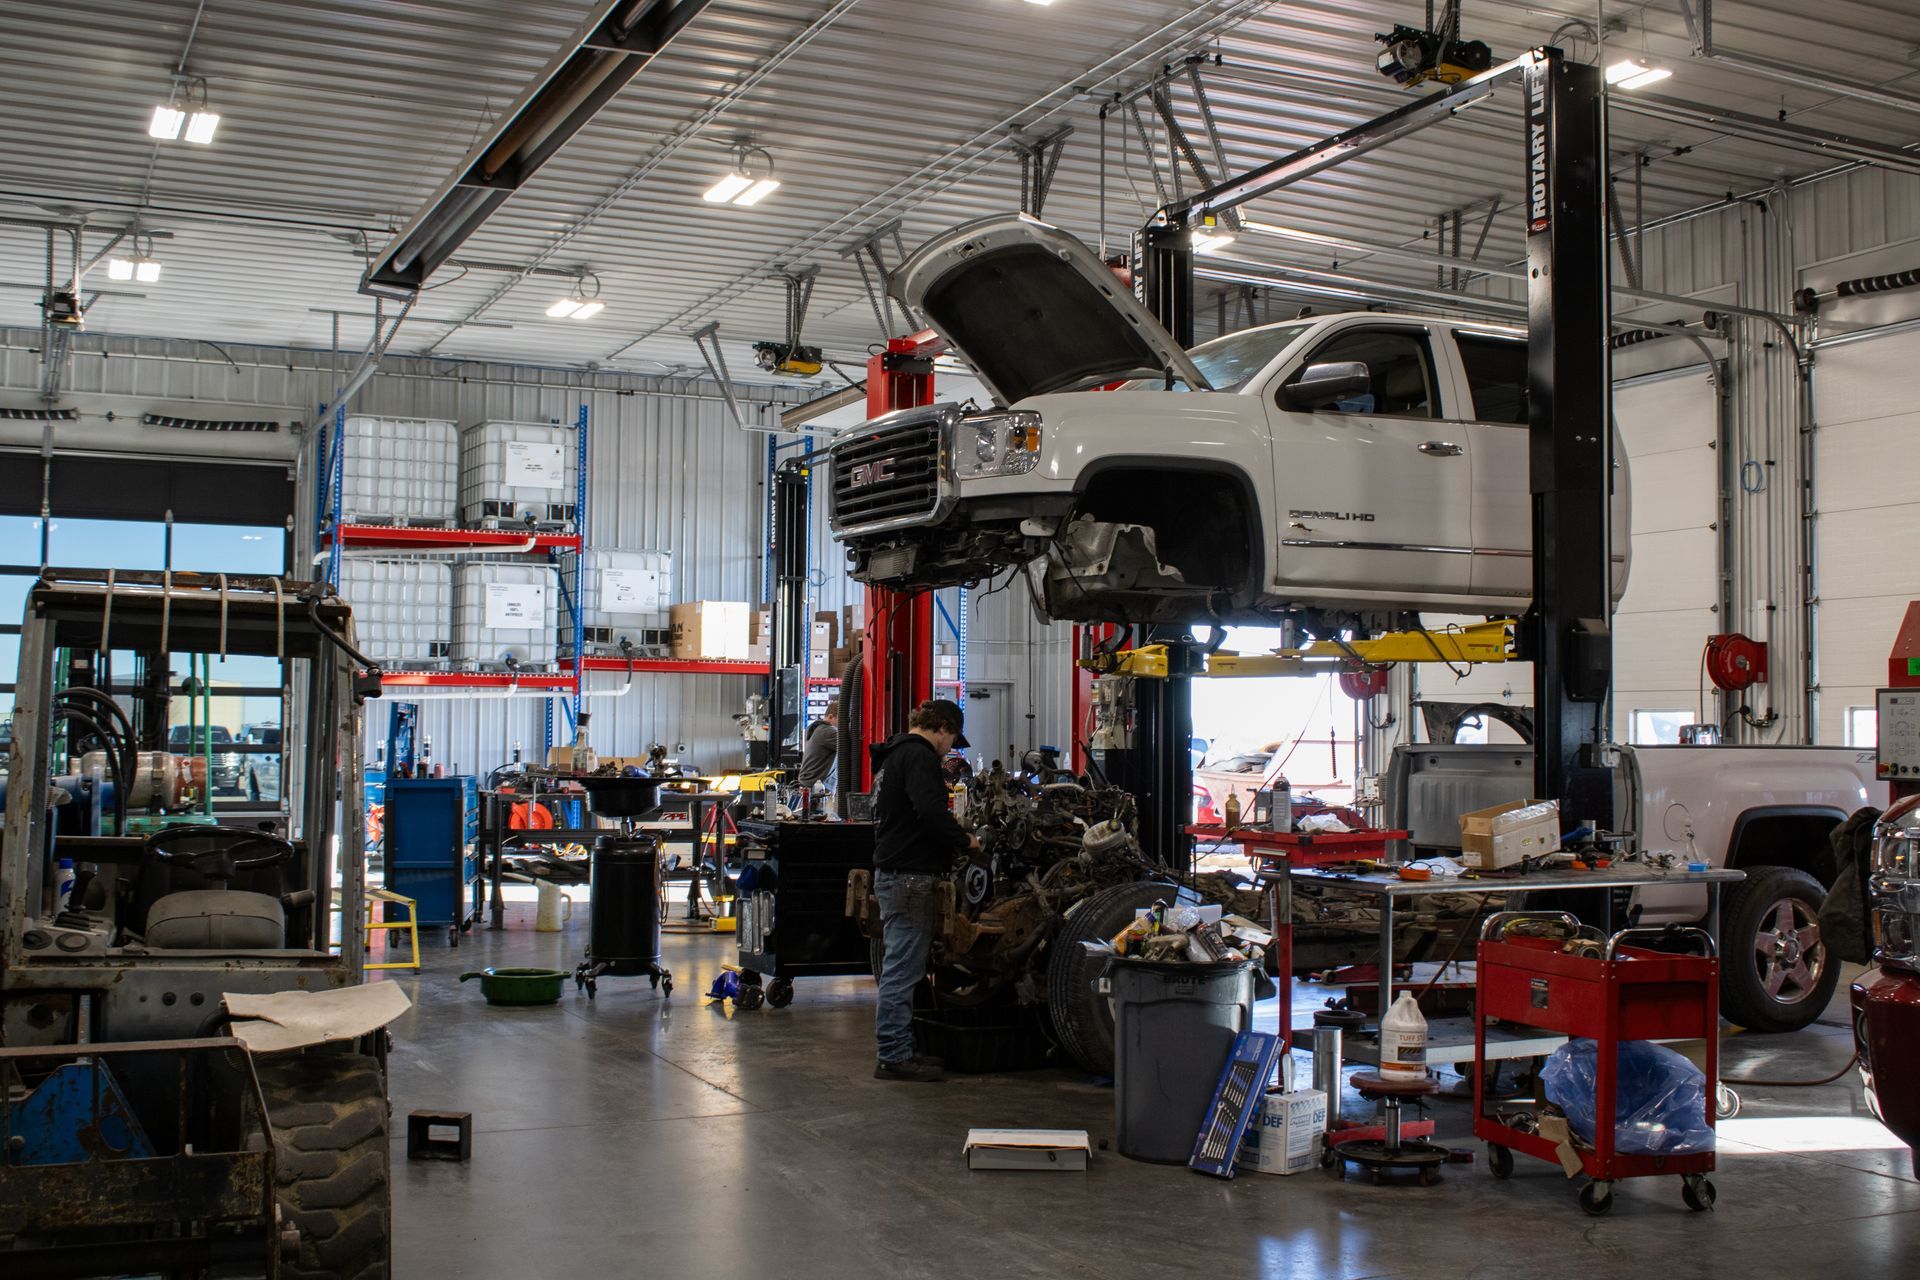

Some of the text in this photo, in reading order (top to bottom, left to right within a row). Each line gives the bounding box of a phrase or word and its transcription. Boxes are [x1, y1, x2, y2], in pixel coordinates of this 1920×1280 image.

[1531, 64, 1547, 219] ROTARY LIFT
[1134, 231, 1143, 270] LIFT
[850, 457, 896, 488] GMC
[1289, 509, 1375, 522] DENALI HD
[1163, 975, 1207, 985] BRUTE
[1399, 1034, 1415, 1042] TUFF
[1263, 1114, 1283, 1128] DEF
[1313, 1110, 1325, 1124] DEF
